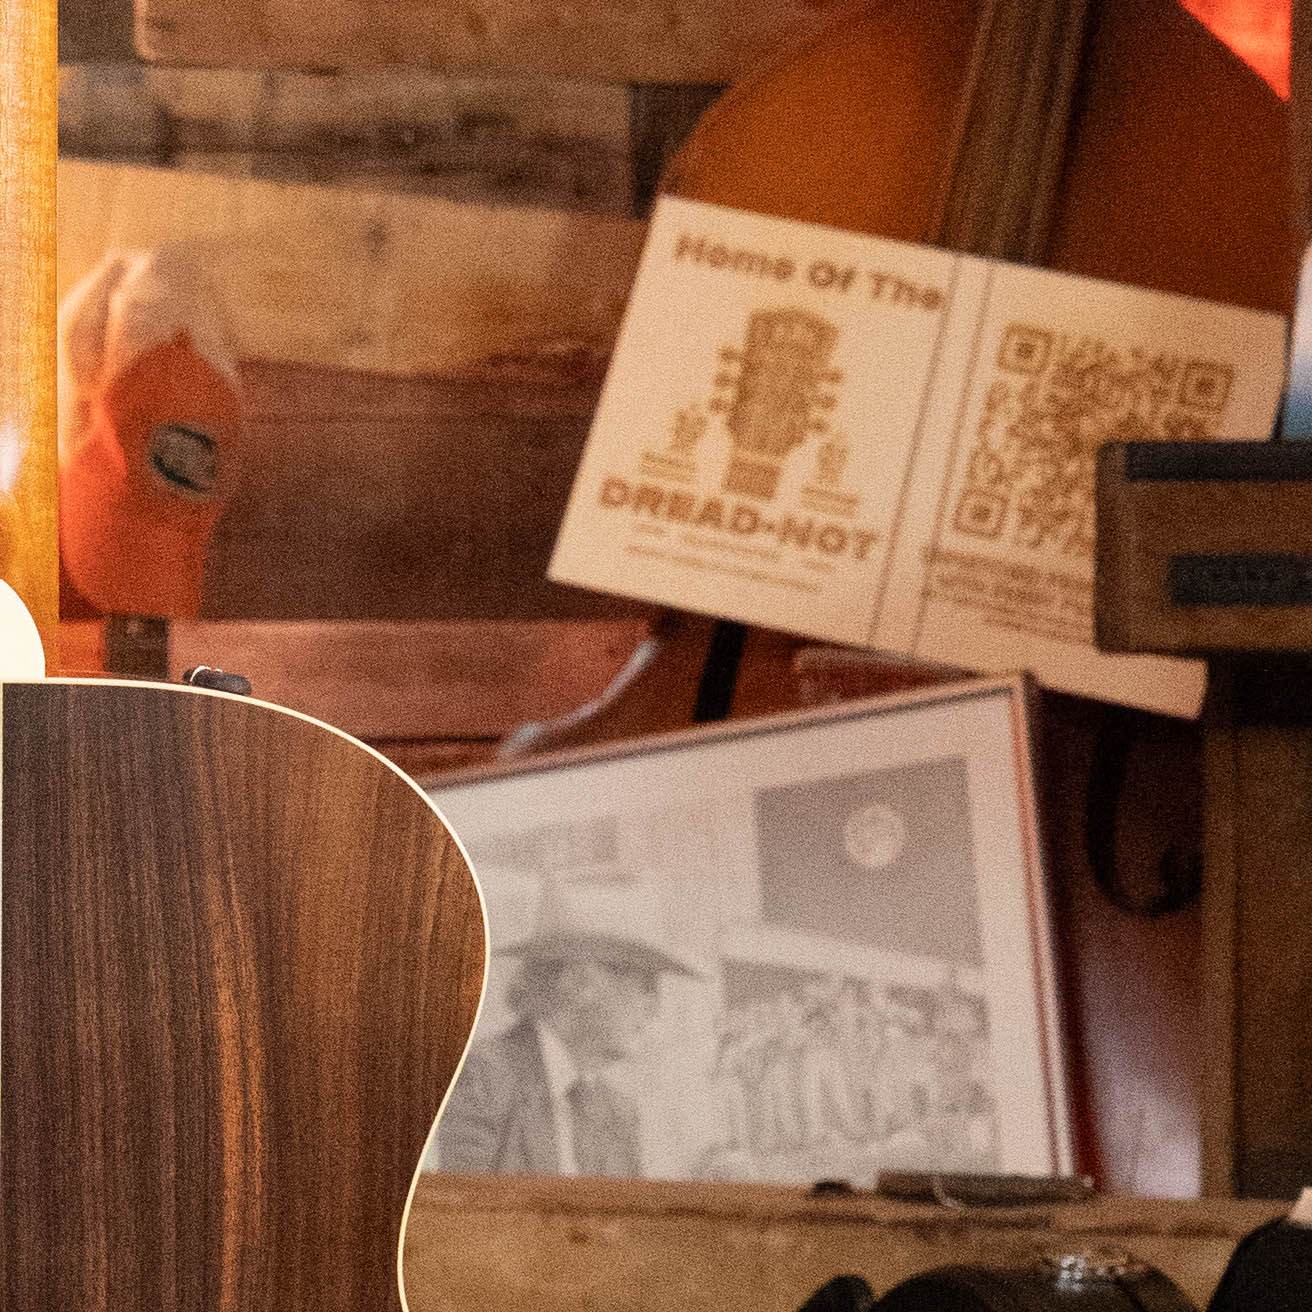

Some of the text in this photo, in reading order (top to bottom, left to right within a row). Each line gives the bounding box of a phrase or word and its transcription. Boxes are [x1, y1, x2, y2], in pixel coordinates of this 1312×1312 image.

[674, 233, 946, 312] Home Of The
[597, 475, 882, 562] DREAD-NOT
